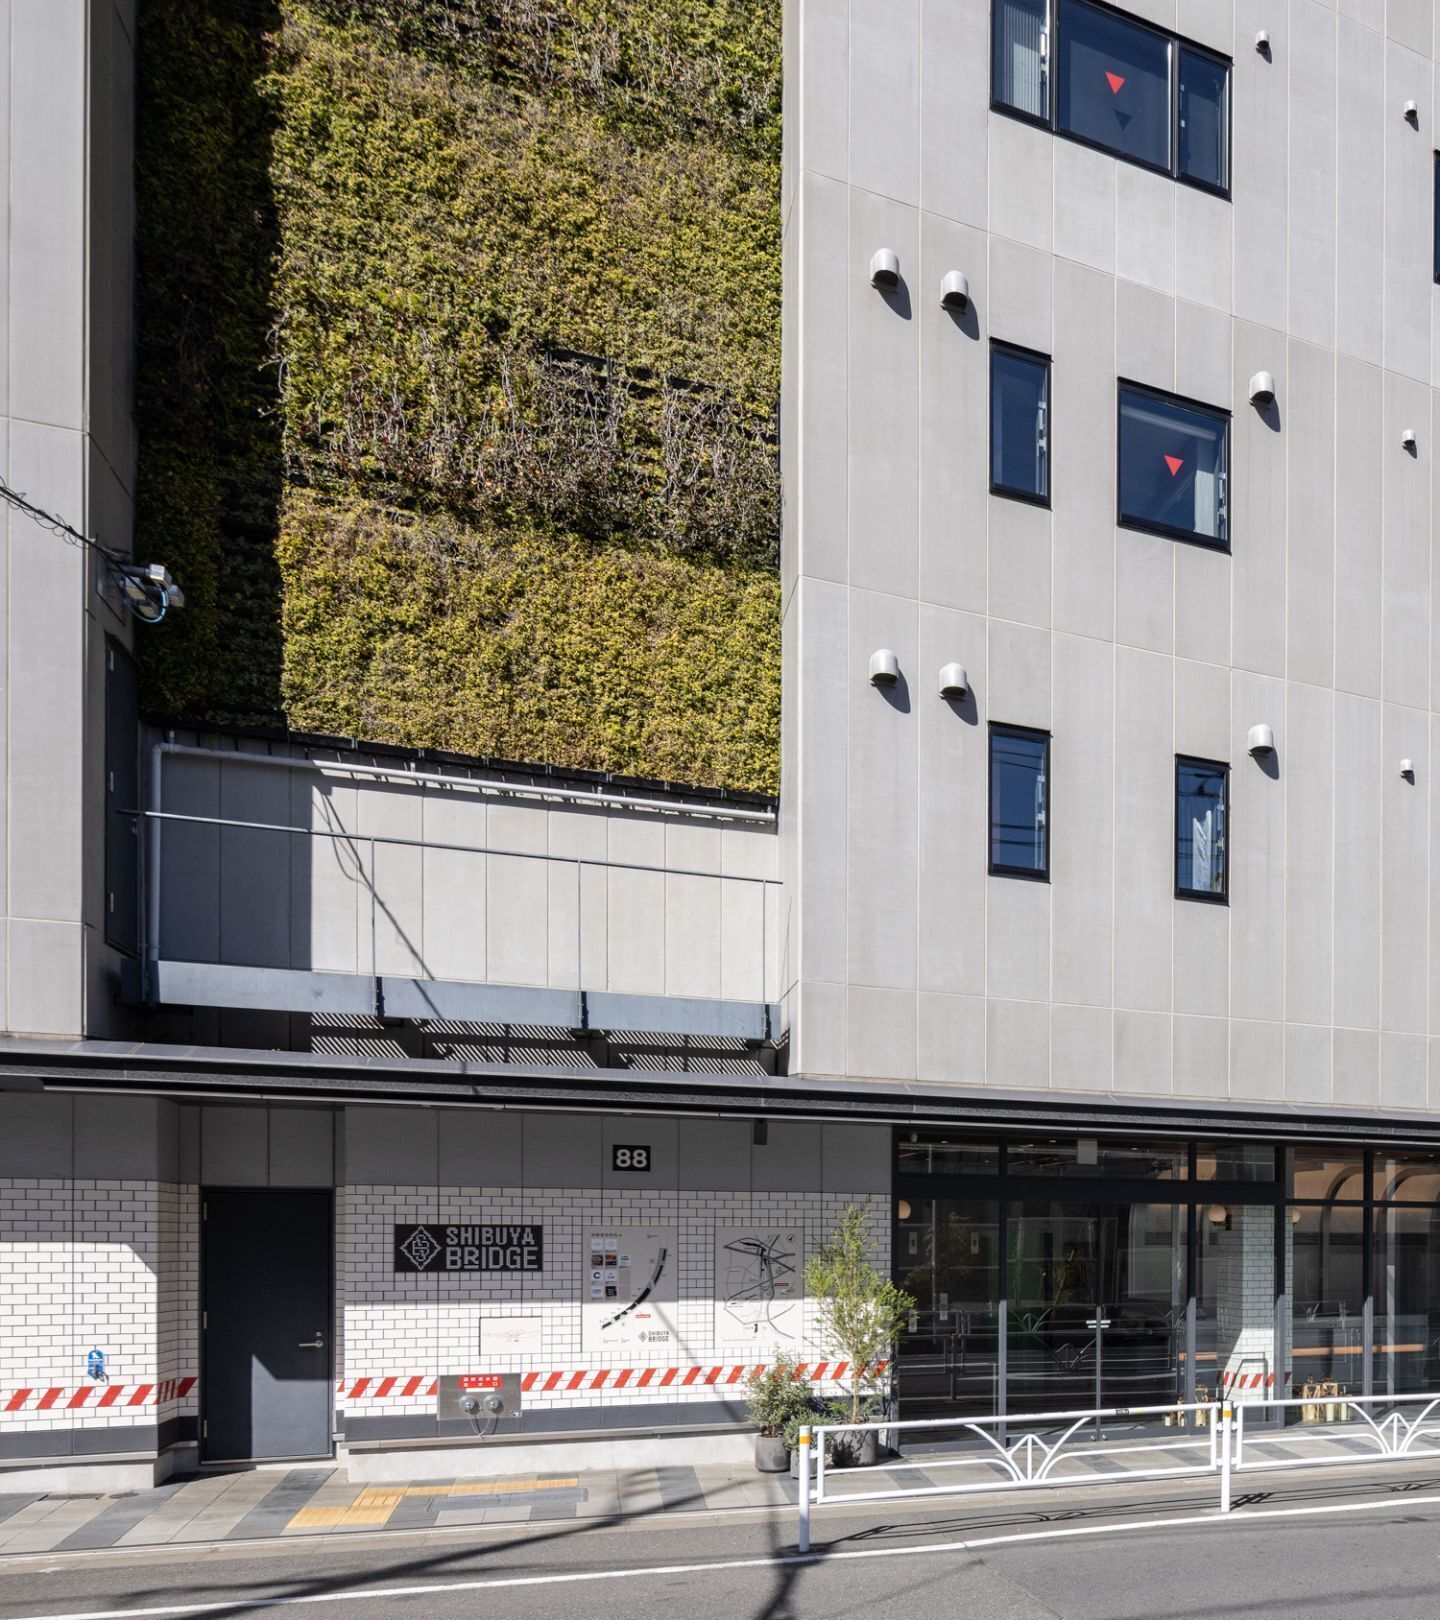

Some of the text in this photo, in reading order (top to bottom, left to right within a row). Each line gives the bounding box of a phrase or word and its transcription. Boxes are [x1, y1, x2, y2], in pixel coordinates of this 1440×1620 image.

[616, 1148, 647, 1168] 88
[446, 1226, 535, 1245] SHIBUYA
[446, 1246, 538, 1269] BRIDGE
